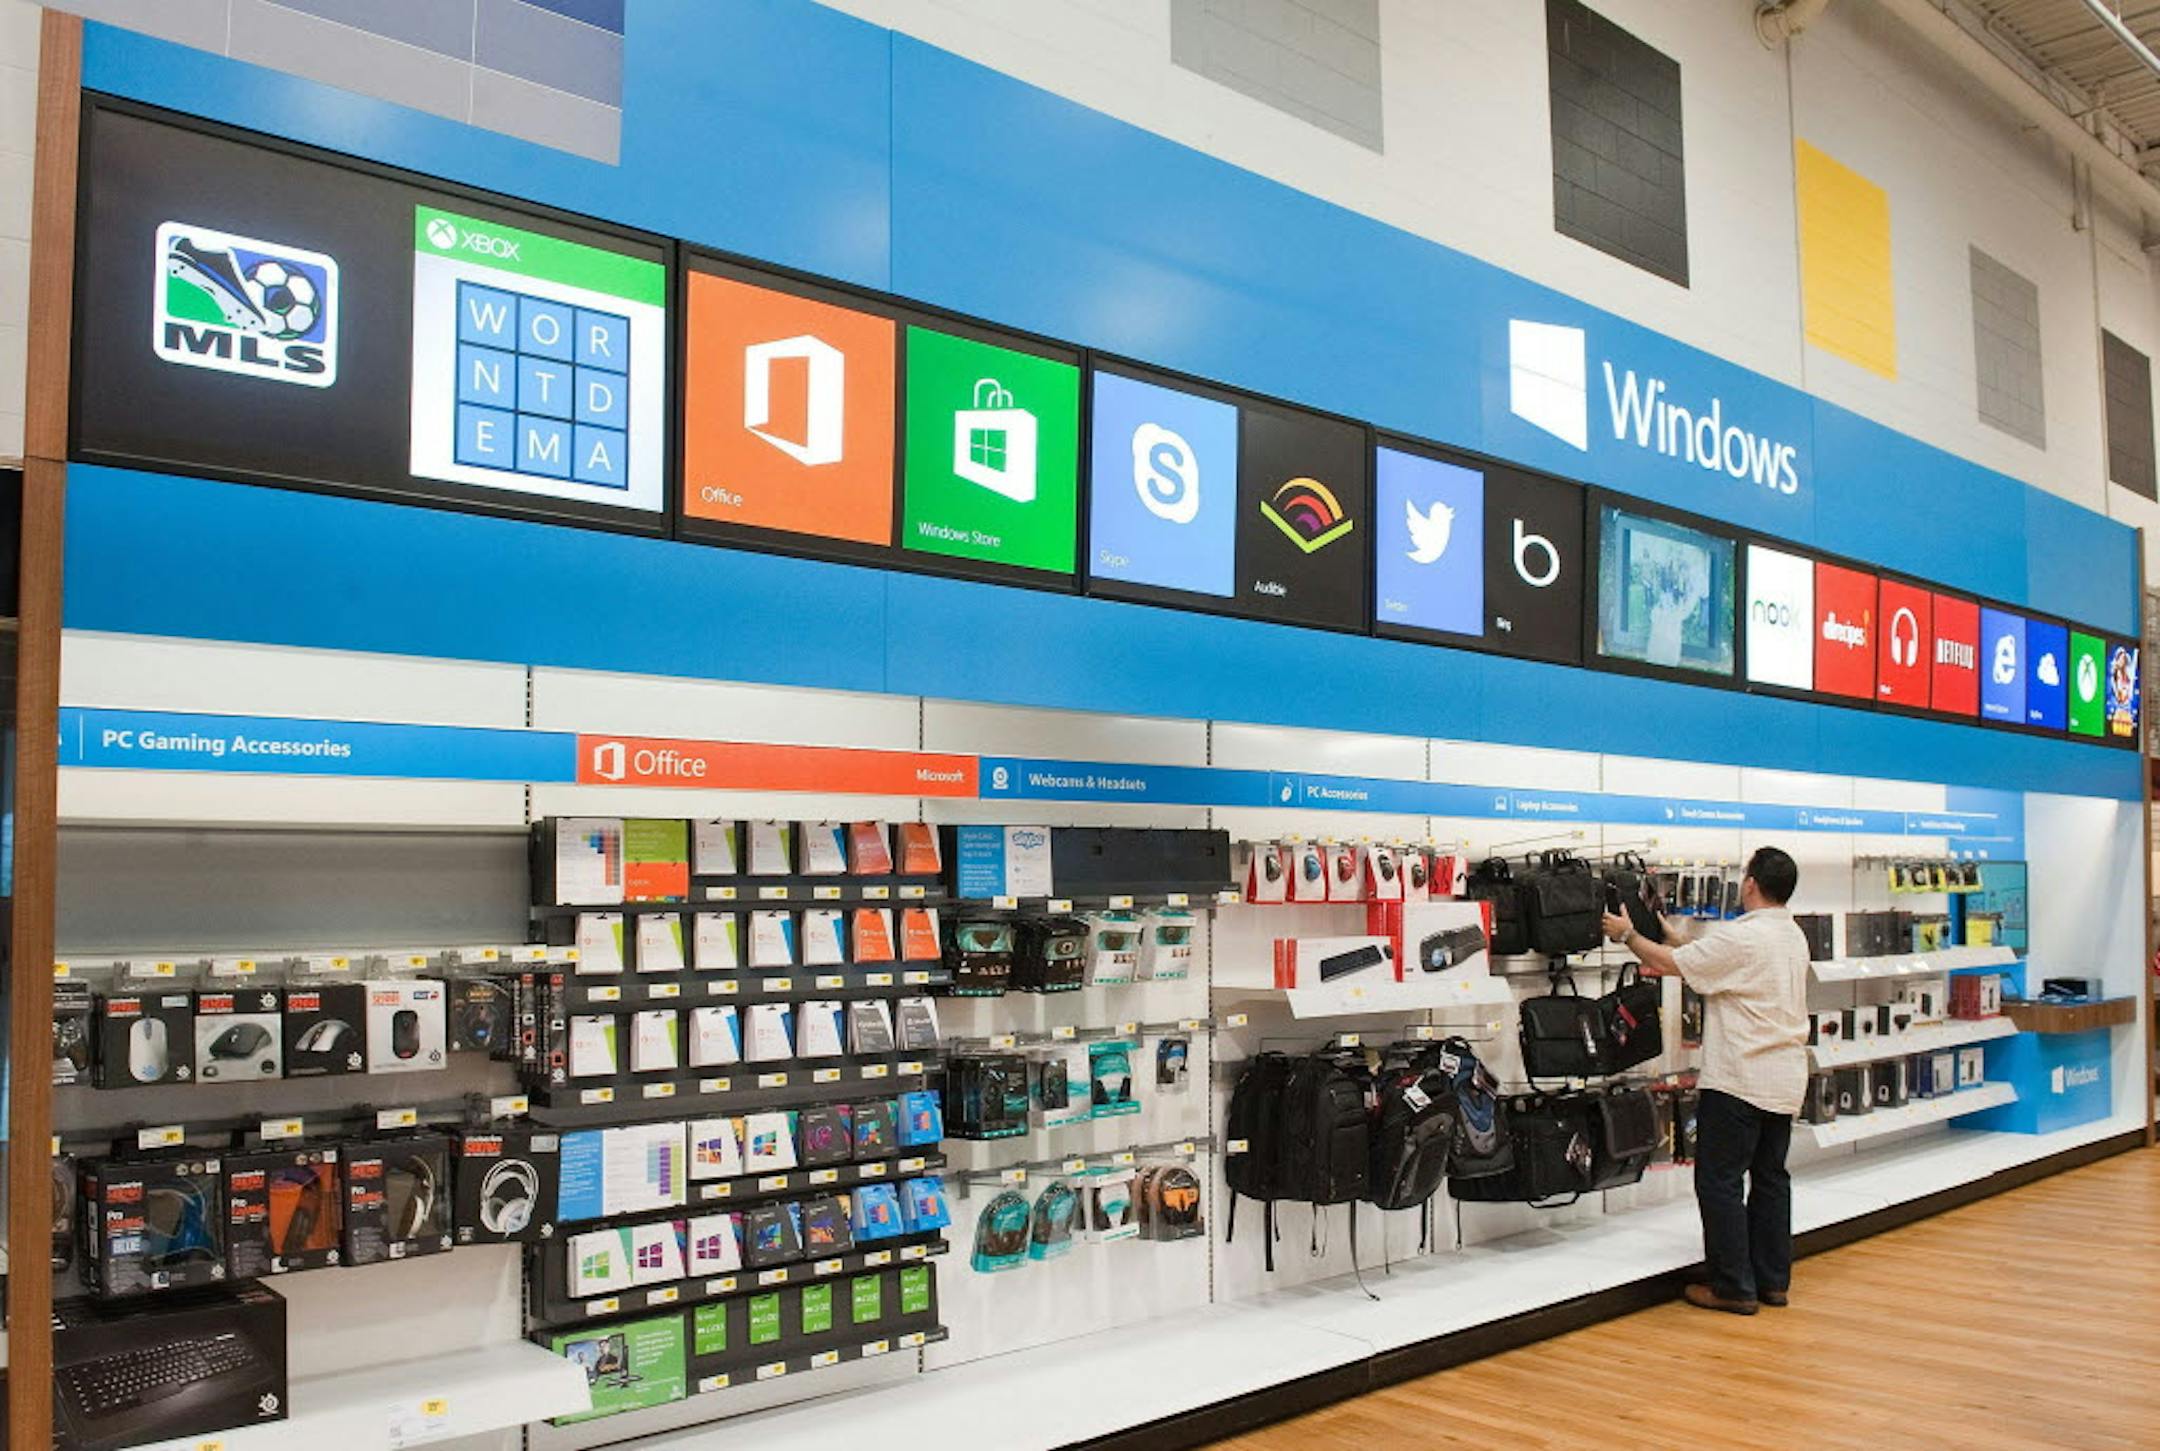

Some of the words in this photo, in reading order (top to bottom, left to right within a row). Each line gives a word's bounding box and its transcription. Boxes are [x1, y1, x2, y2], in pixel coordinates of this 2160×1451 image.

[461, 229, 521, 262] XBOX
[469, 298, 507, 335] W
[531, 313, 560, 346] O
[590, 325, 612, 358] R
[164, 322, 326, 374] MLS
[474, 359, 500, 394] N
[535, 371, 556, 404] T
[589, 382, 613, 413] D
[1602, 360, 1799, 495] Windows
[476, 421, 495, 453] E
[528, 428, 560, 463] M
[587, 441, 612, 472] A
[701, 485, 743, 507] Office
[917, 521, 970, 544] Windows
[971, 532, 1001, 548] Store
[1752, 599, 1799, 628] noo
[102, 729, 133, 749] PC
[138, 731, 225, 757] Gaming
[231, 735, 352, 758] Accessories
[633, 749, 707, 778] Office
[916, 767, 965, 784] Microsoft
[1028, 772, 1084, 791] Webcams
[1086, 775, 1097, 790] &
[1098, 776, 1147, 792] Headsets
[1307, 785, 1320, 799] PC
